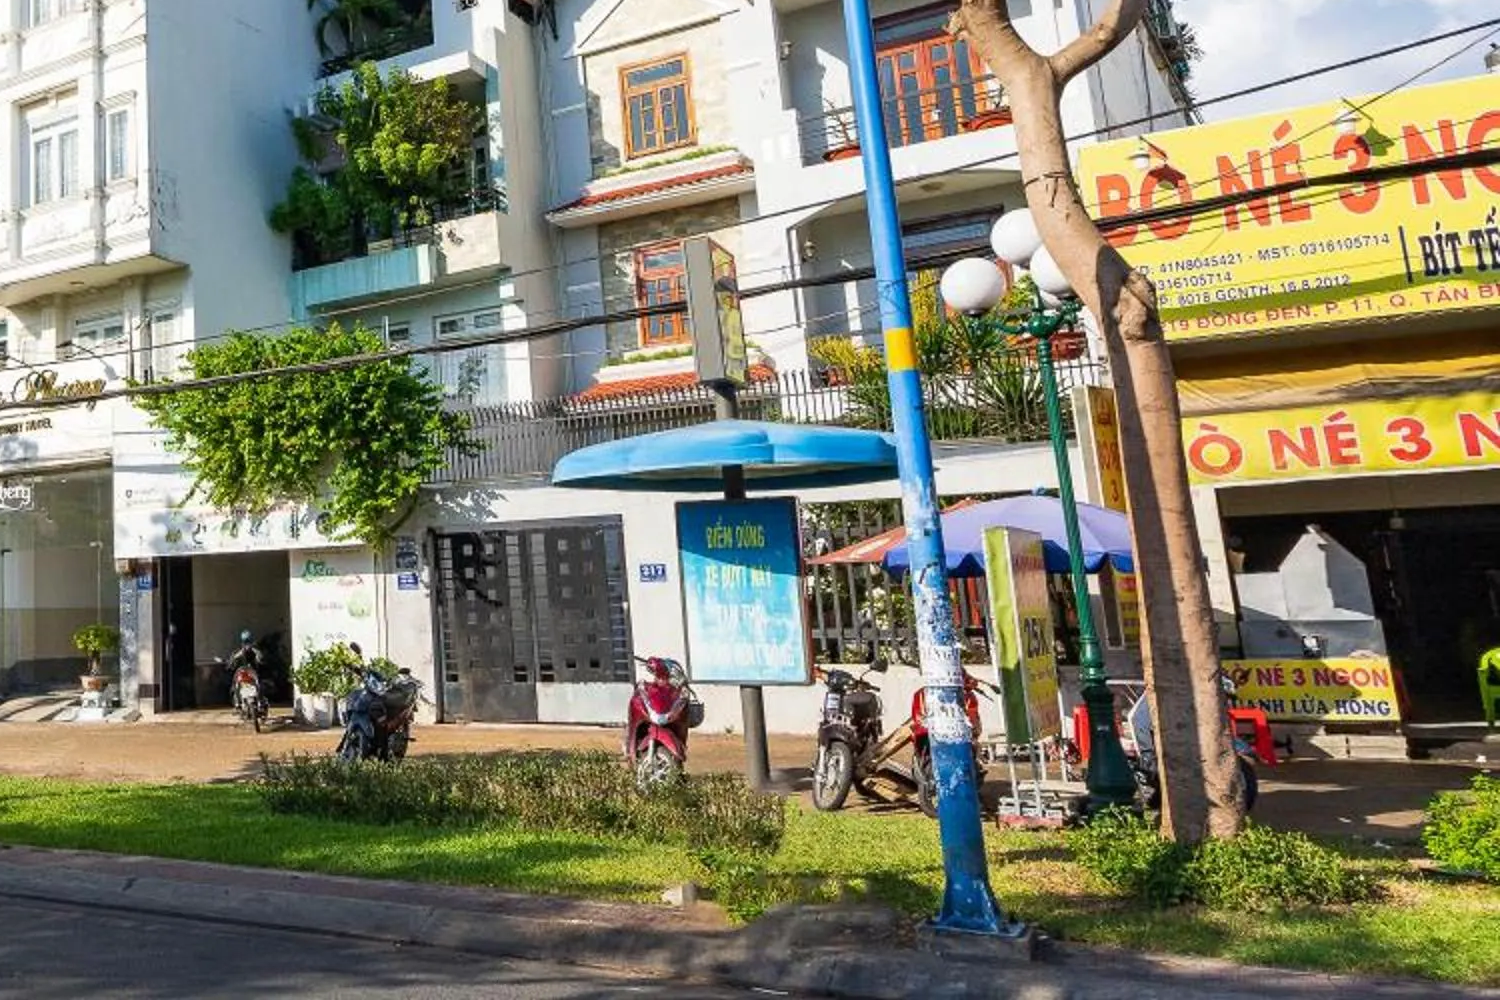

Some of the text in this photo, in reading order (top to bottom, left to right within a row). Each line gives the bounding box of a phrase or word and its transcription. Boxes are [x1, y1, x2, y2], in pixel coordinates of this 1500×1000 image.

[1216, 120, 1313, 232] NÉ
[1333, 132, 1382, 214] 3
[1258, 246, 1296, 261] MST:
[1299, 233, 1390, 256] 0316105714
[1418, 221, 1464, 277] BÍT
[1420, 286, 1470, 304] TÂN
[1188, 423, 1243, 476] Ò
[1268, 410, 1361, 470] NÉ
[1386, 417, 1433, 462] 3
[1256, 663, 1285, 686] NÉ
[1292, 667, 1305, 687] 3
[1312, 667, 1389, 688] NGON
